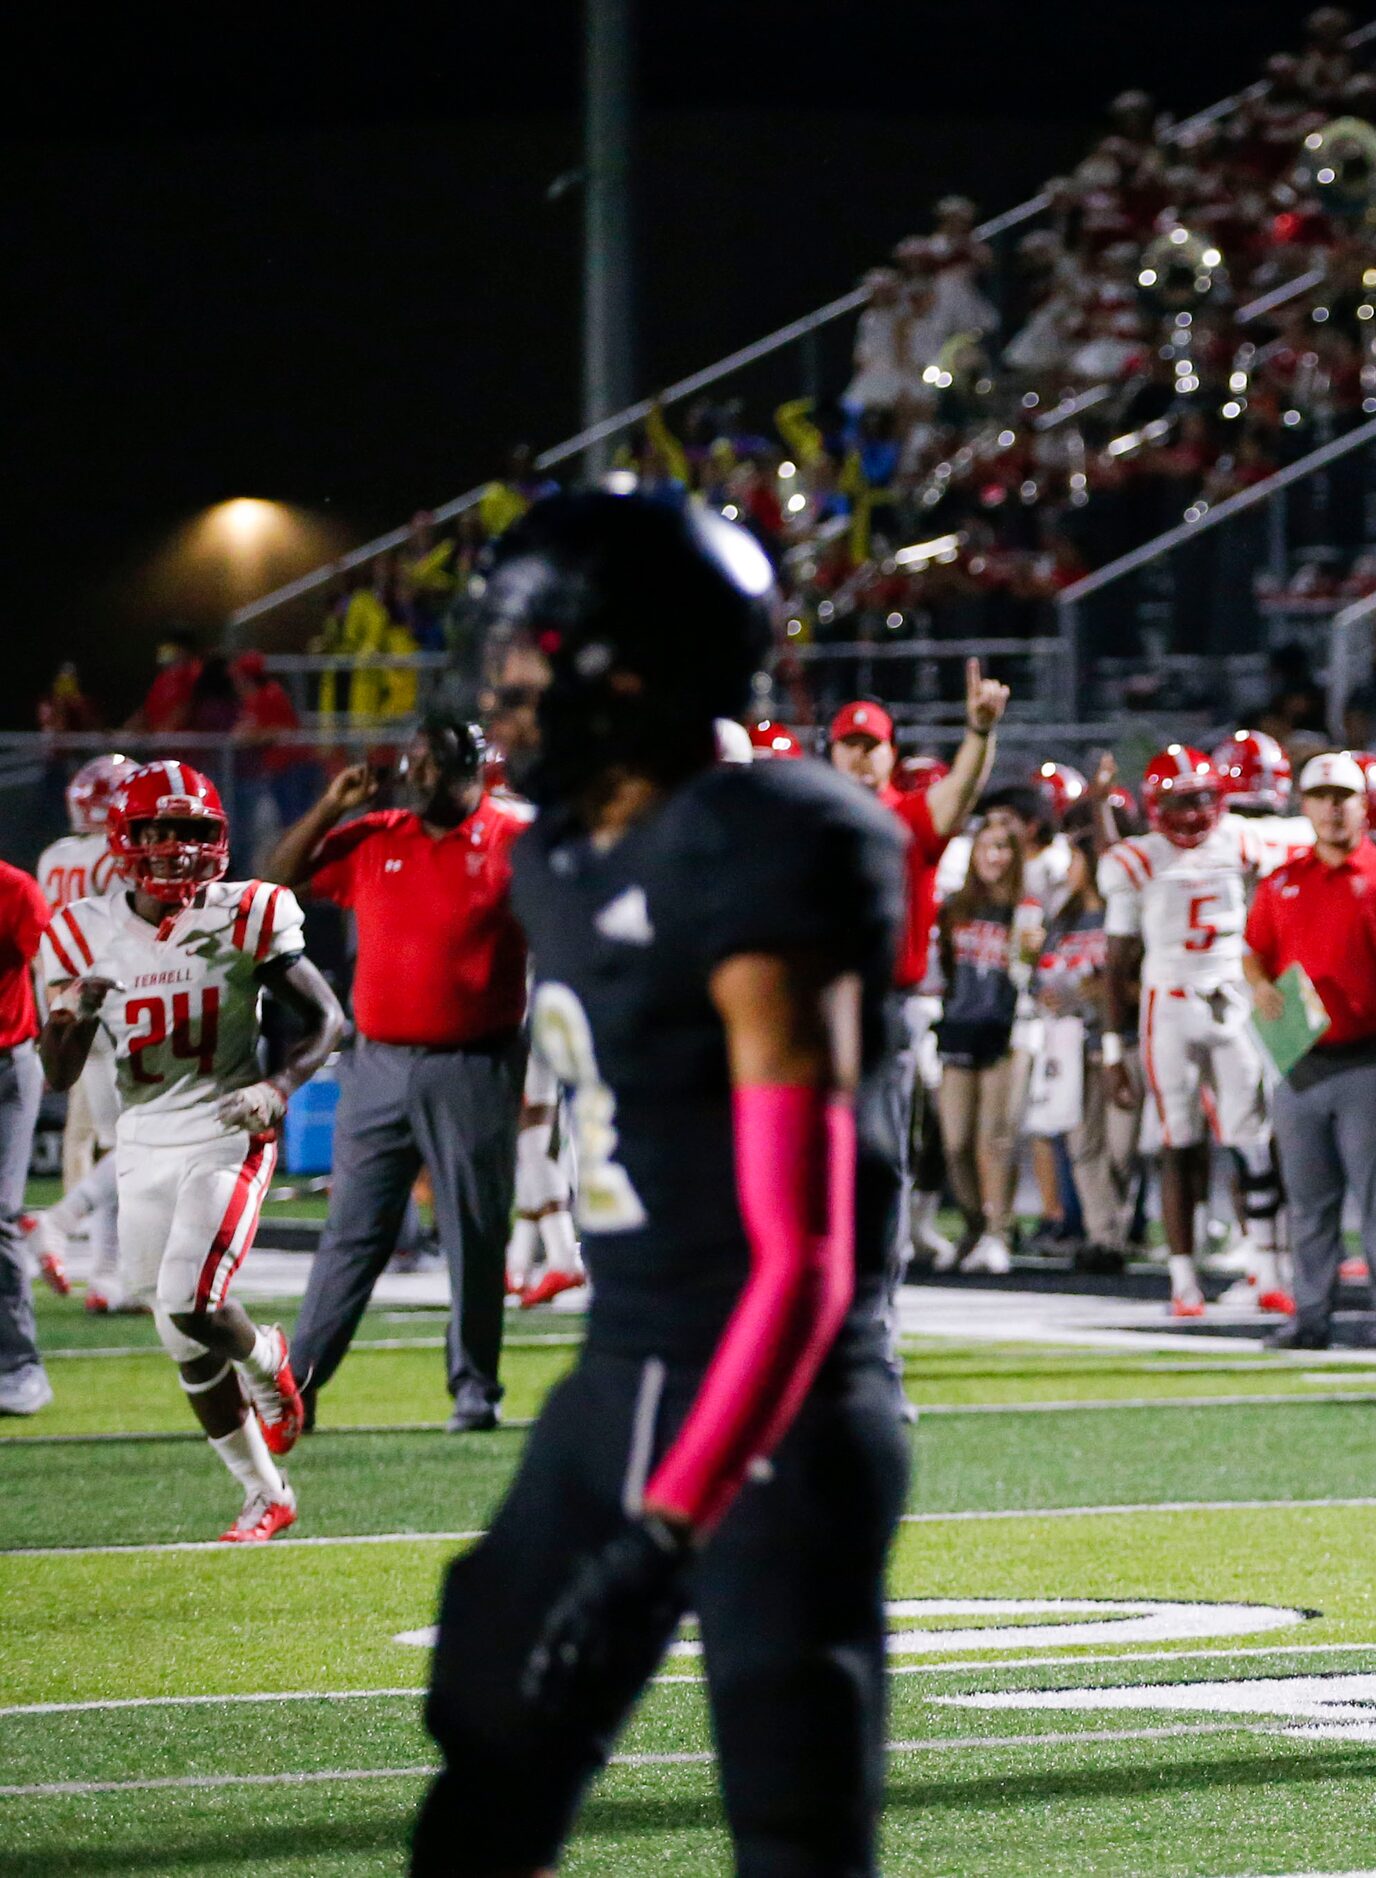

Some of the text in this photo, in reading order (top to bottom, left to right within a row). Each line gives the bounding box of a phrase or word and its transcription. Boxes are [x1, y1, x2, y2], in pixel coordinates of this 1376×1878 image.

[1184, 896, 1218, 951] 5
[134, 969, 193, 988] TERRELL
[125, 985, 219, 1084] 24
